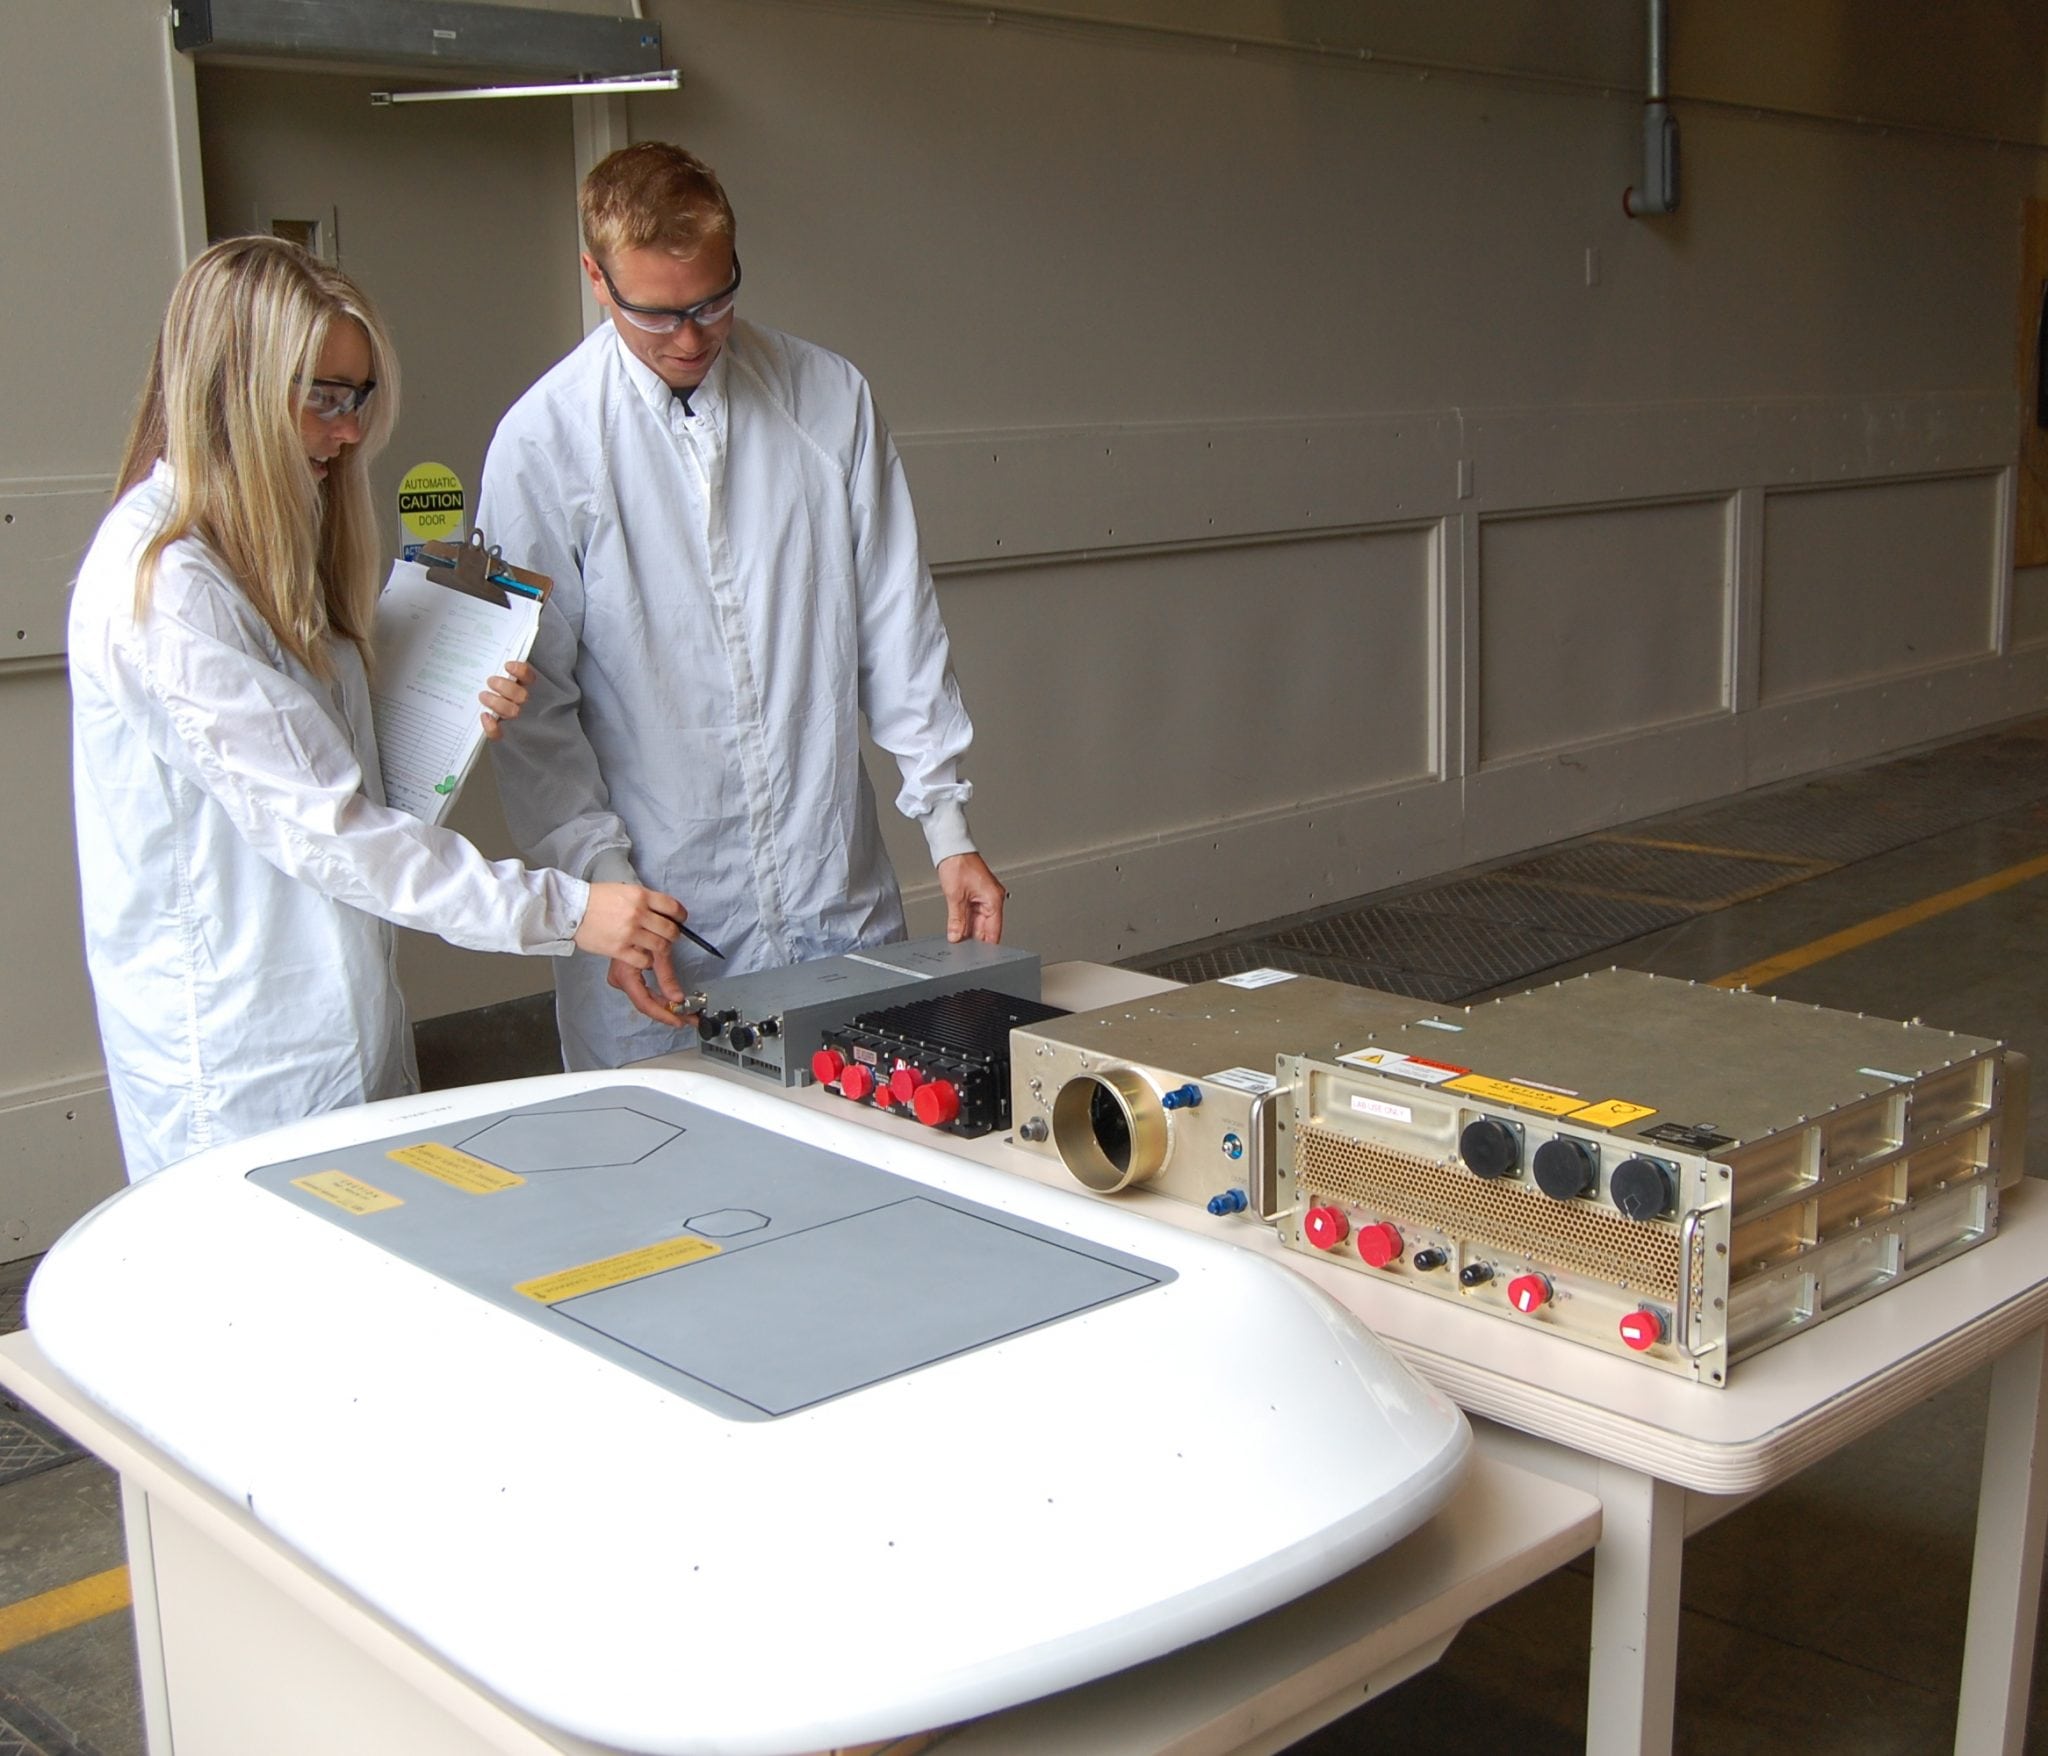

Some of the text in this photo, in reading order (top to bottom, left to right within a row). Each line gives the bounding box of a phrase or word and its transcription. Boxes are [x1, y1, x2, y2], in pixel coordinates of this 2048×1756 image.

[404, 477, 457, 490] AUTOMATIC
[401, 493, 462, 510] CAUTION
[418, 514, 446, 526] DOOR
[1353, 1101, 1404, 1117] LAB USE ONLY
